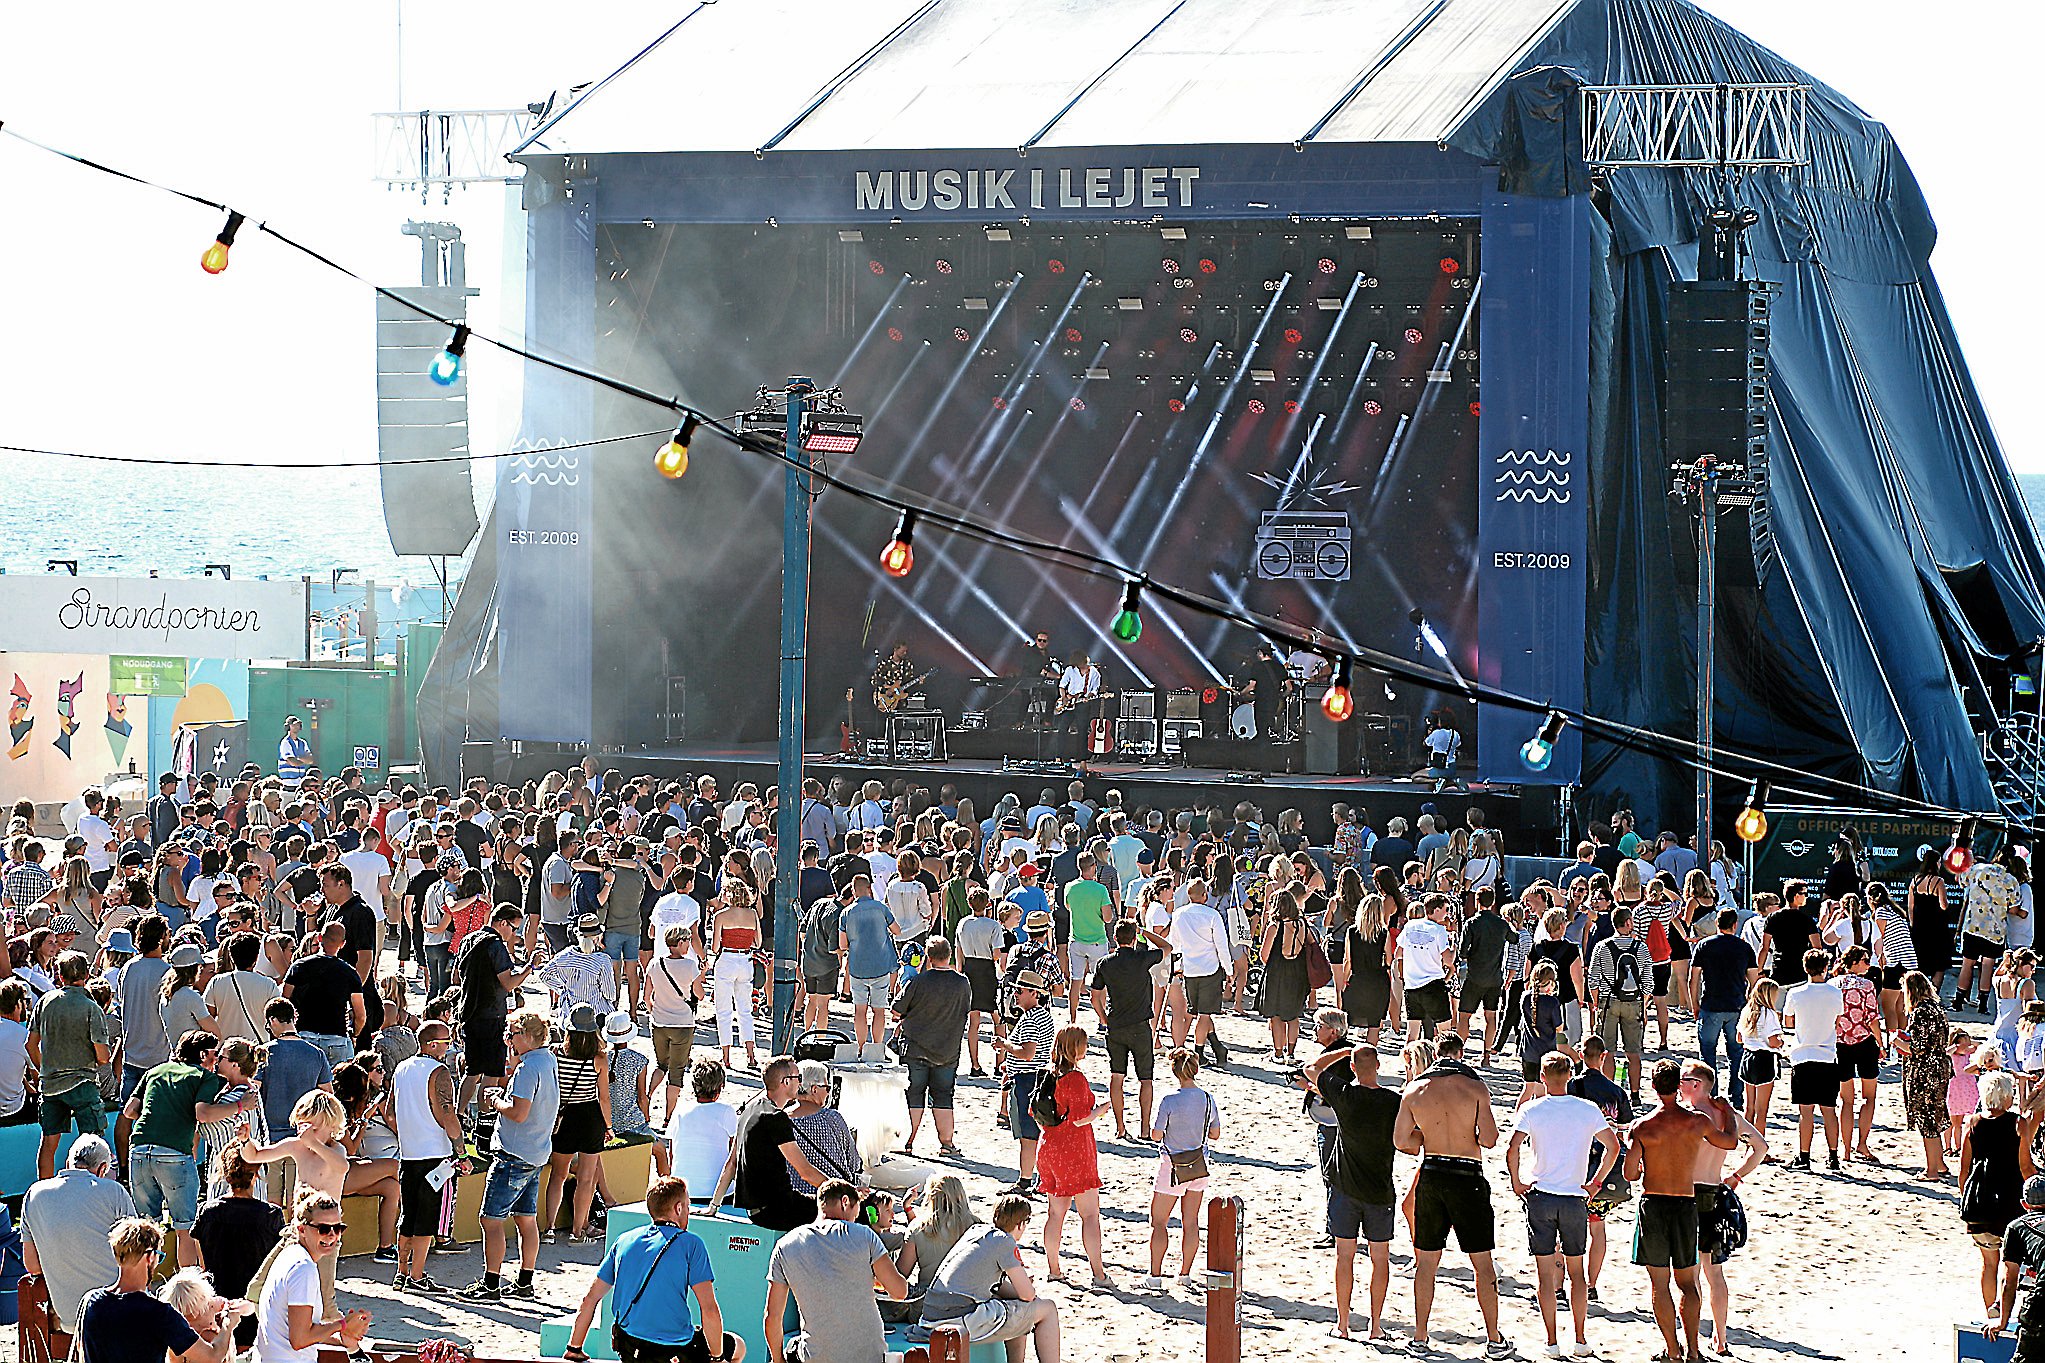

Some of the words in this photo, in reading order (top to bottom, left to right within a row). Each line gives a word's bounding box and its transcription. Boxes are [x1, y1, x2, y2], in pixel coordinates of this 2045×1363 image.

[855, 169, 1017, 211] MUSIK
[1029, 168, 1045, 210] I
[1059, 166, 1201, 209] LEJET
[509, 531, 538, 544] EST.
[540, 531, 579, 545] 2009
[729, 1236, 760, 1246] MEETING
[729, 1243, 750, 1252] POINT
